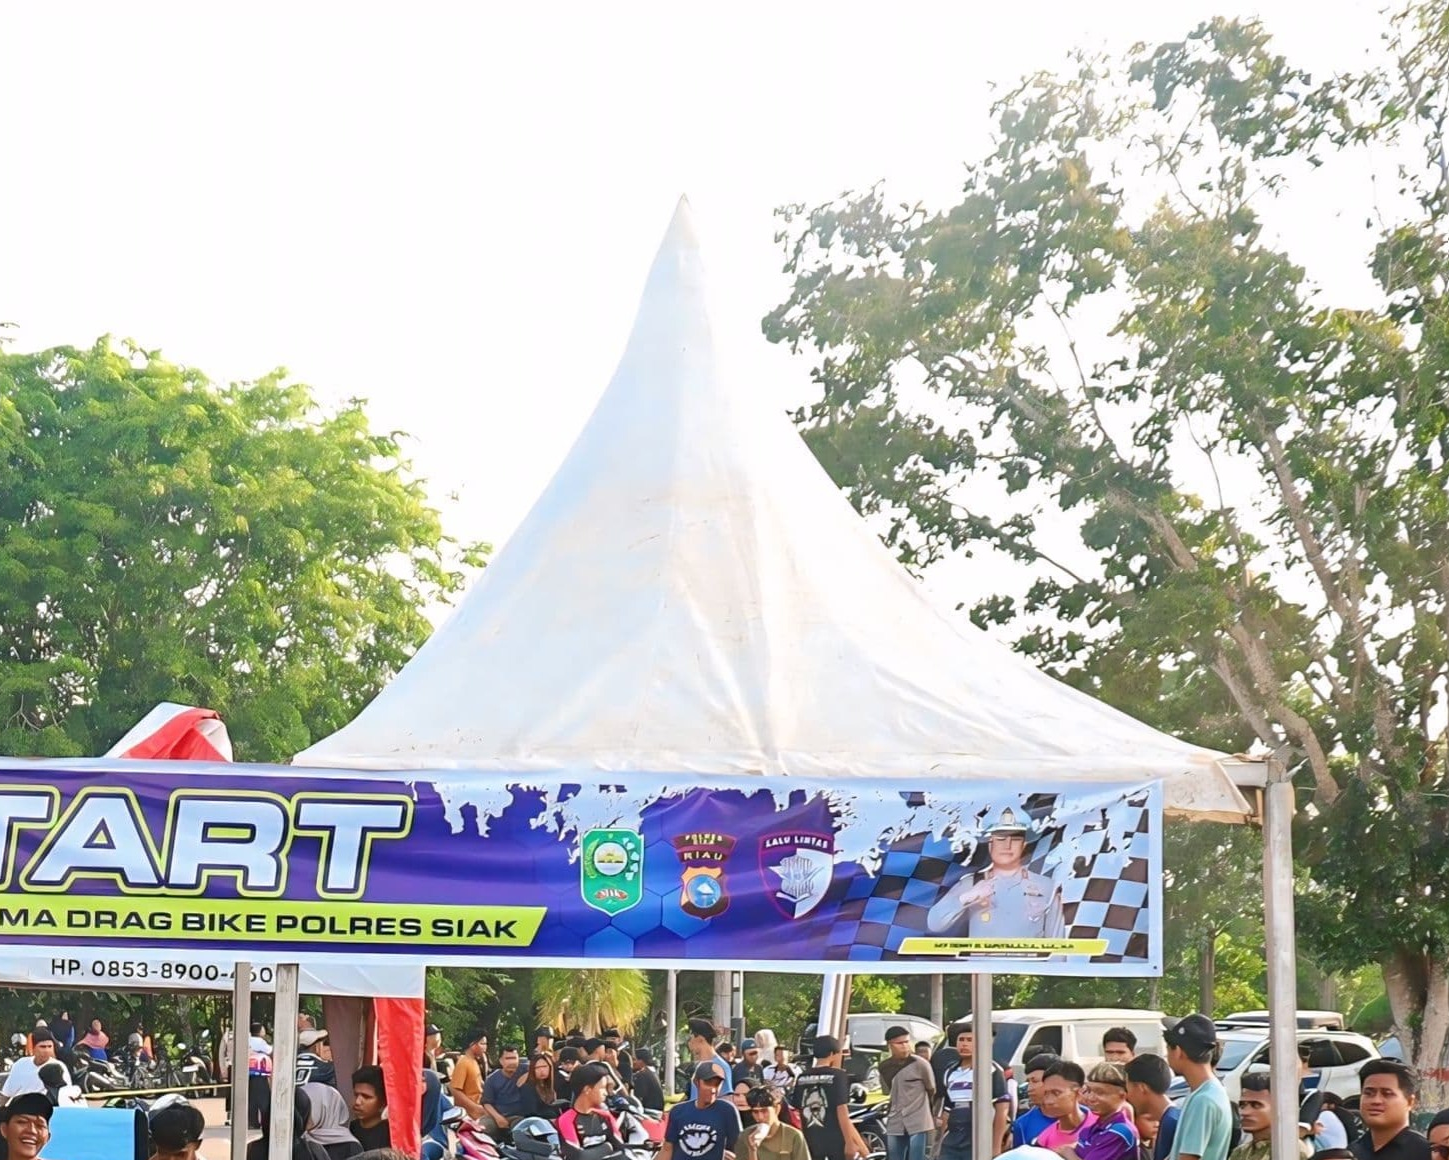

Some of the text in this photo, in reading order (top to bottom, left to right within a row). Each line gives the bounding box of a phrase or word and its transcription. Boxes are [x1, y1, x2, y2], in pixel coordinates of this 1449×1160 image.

[765, 835, 829, 849] LALU LINTAS
[683, 852, 723, 861] RIAU
[67, 909, 172, 930] DRAG
[181, 912, 267, 934] BIKE
[276, 914, 422, 937] POLRES
[432, 918, 518, 939] SIAK
[51, 959, 85, 977] HP.
